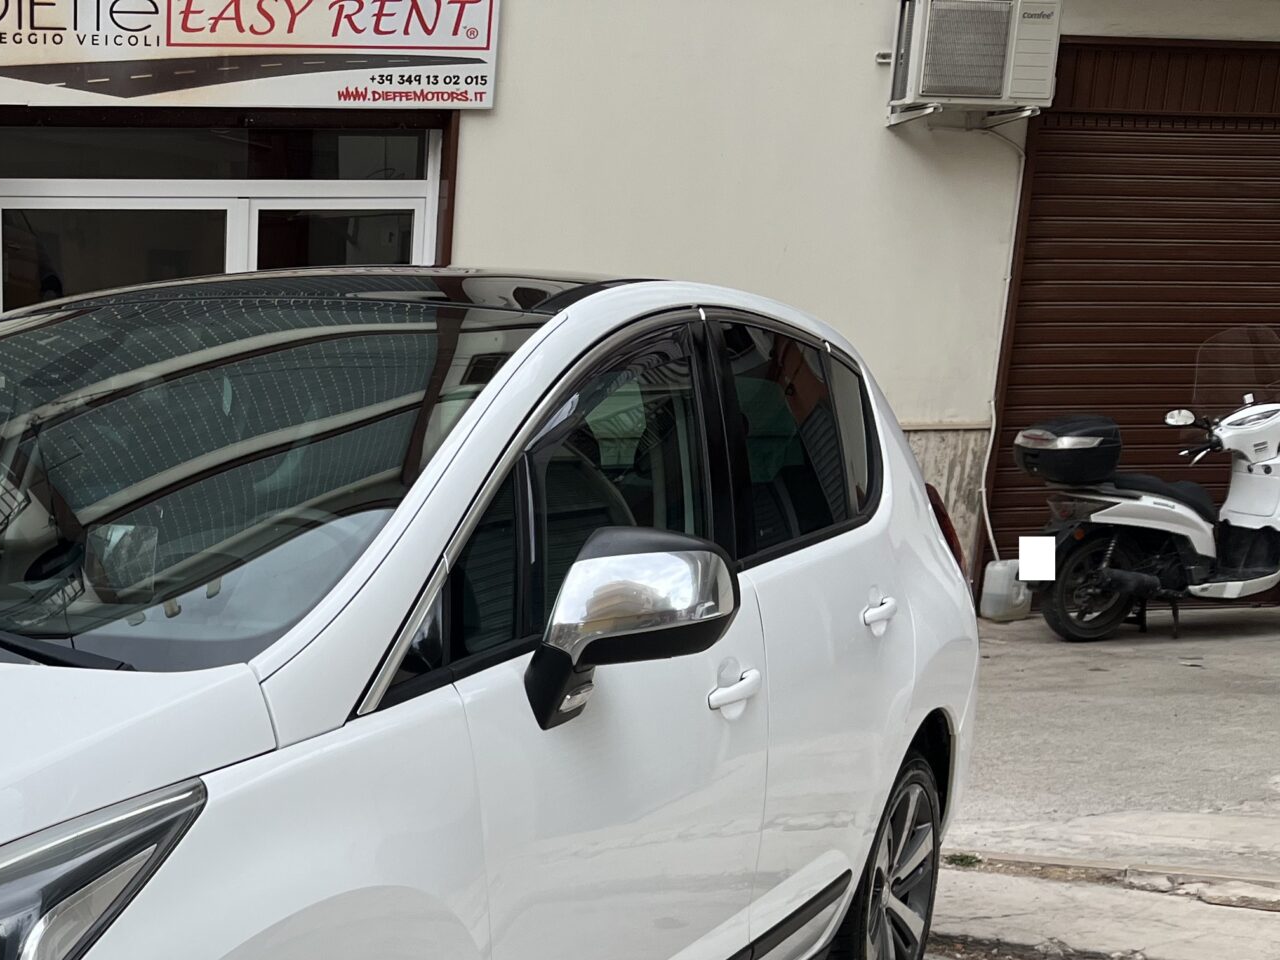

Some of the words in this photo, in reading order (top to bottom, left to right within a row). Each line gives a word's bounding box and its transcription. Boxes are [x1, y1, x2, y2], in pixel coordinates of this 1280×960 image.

[76, 34, 161, 47] VEICOLI
[370, 74, 393, 85] +39
[397, 74, 421, 85] 349
[426, 75, 439, 85] 13
[443, 75, 461, 85] 02
[464, 75, 488, 86] 015
